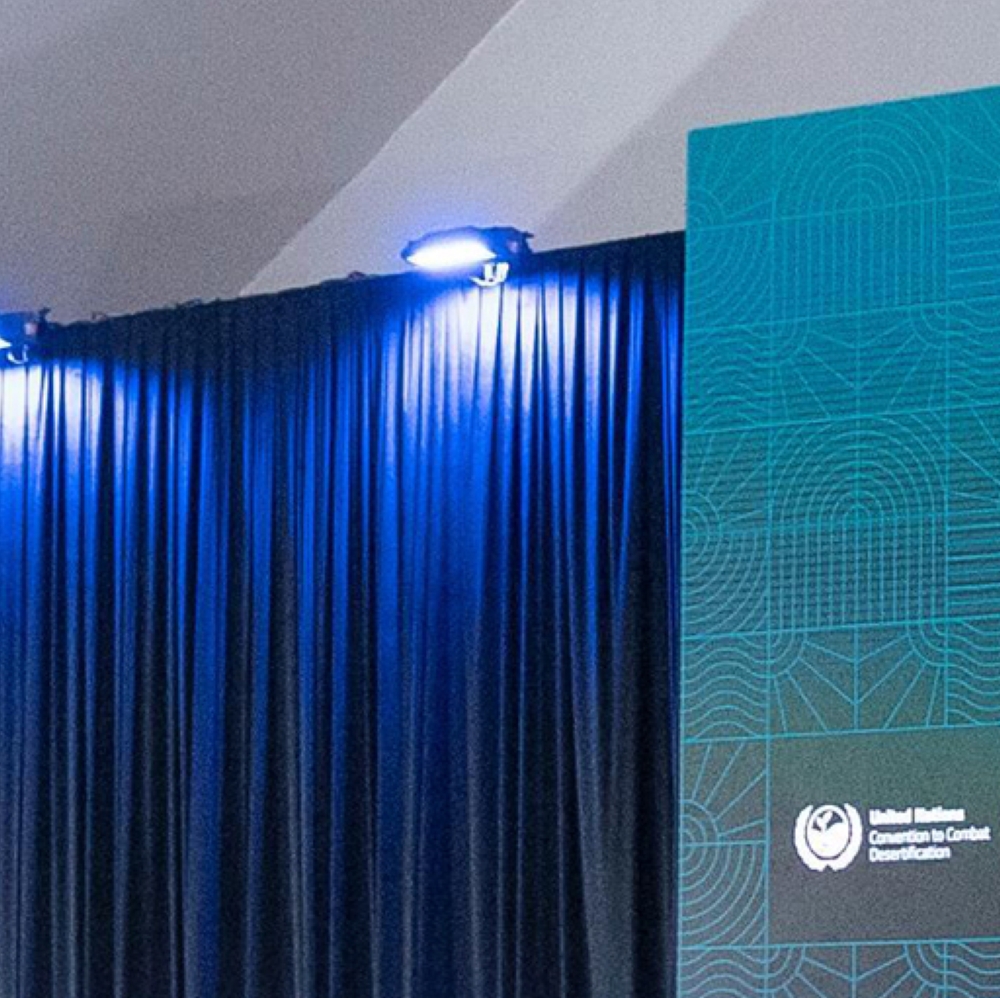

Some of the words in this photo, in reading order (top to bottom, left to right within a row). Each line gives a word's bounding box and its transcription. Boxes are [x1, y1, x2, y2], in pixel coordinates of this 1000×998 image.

[869, 807, 913, 825] United
[914, 806, 965, 823] Nations
[931, 829, 945, 842] to
[946, 826, 991, 841] Combat
